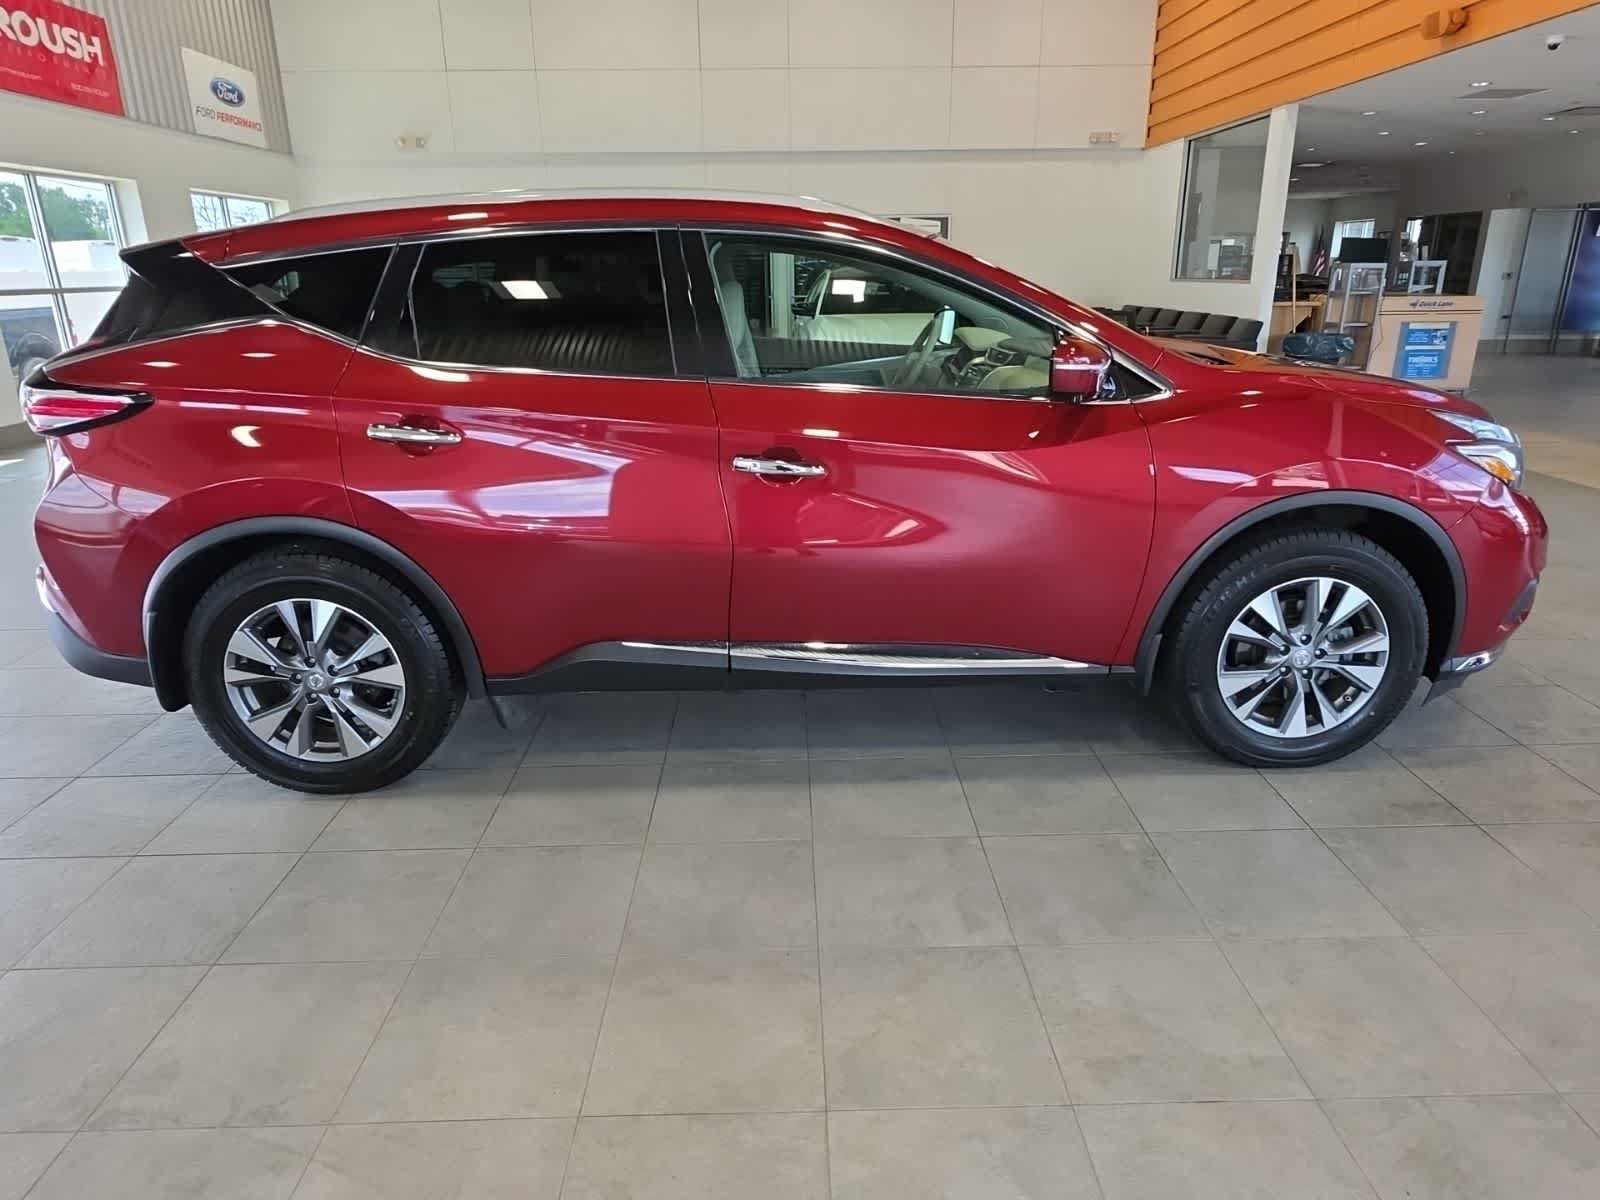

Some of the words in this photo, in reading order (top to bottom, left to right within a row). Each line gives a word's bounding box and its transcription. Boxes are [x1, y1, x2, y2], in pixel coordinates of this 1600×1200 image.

[0, 6, 103, 66] ROUSH
[216, 81, 239, 103] Ford
[196, 105, 215, 119] FORD
